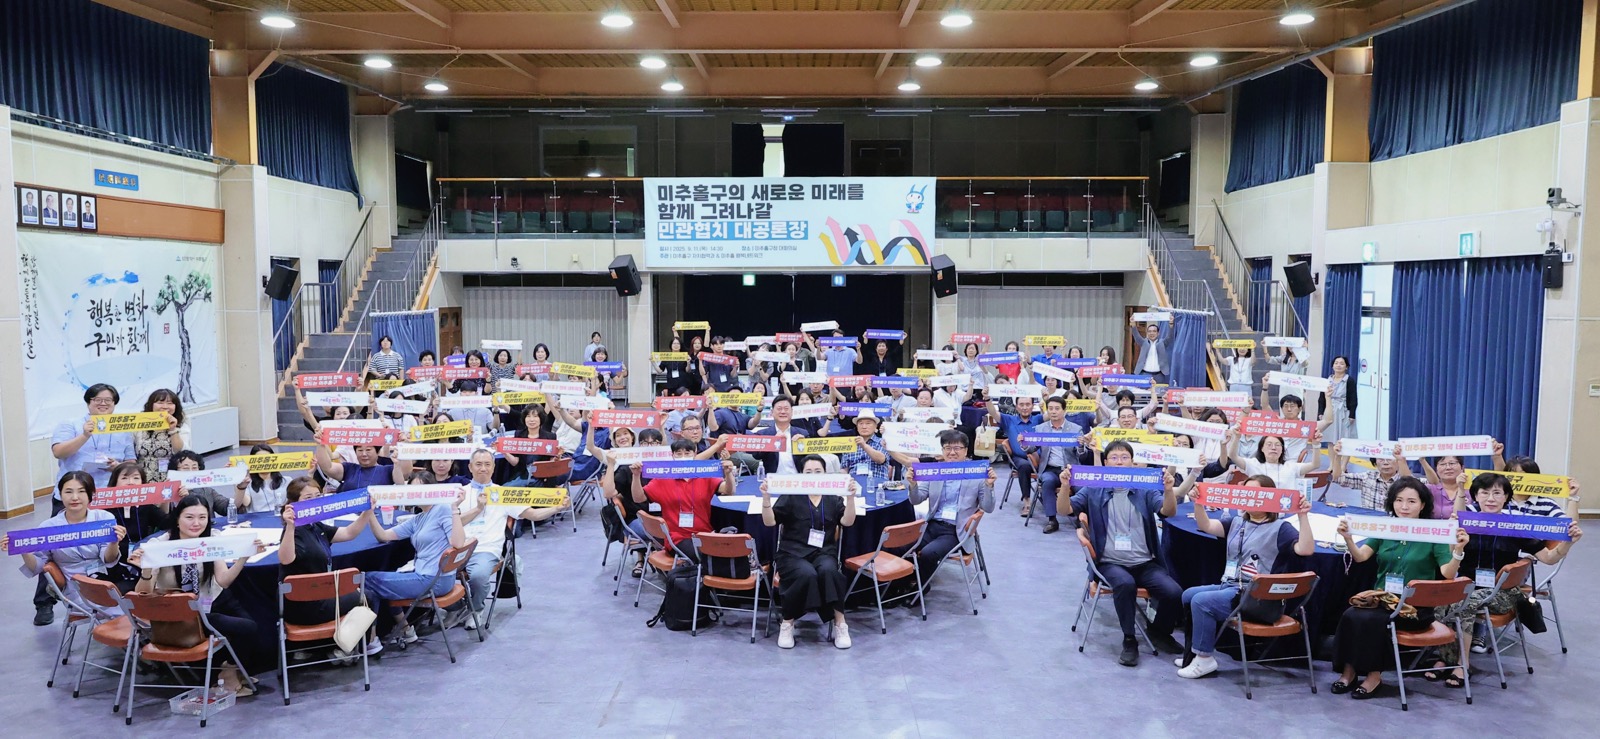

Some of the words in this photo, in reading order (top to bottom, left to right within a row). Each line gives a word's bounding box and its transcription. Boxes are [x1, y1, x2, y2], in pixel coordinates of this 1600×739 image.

[658, 184, 744, 202] 미추홀구의
[752, 184, 804, 201] 새로운
[811, 184, 864, 201] 미래를
[658, 202, 694, 220] 함께
[700, 202, 773, 220] 그려나갈
[658, 221, 728, 239] 민관협치
[734, 221, 807, 239] 대공론장
[87, 299, 122, 328] 행복한
[124, 287, 148, 328] 변화
[85, 328, 124, 356] 구민과
[127, 322, 150, 355] 함께
[1456, 442, 1488, 450] 네트워크
[1074, 472, 1101, 480] 미추홀구
[1104, 474, 1131, 482] 민관협치
[374, 492, 405, 500] 미추홀구
[425, 491, 454, 499] 네트워크
[1207, 487, 1230, 495] 주민과
[1232, 488, 1256, 498] 행정이
[1258, 490, 1274, 498] 함께
[1206, 495, 1229, 504] 만드는
[1231, 497, 1264, 507] 미추홀구
[1351, 522, 1387, 532] 미추홀구
[1390, 525, 1408, 534] 행복
[1411, 526, 1450, 537] 네트워크
[1462, 520, 1496, 528] 미추홀구
[1498, 522, 1532, 531] 민관협치
[14, 536, 45, 547] 미추홀구
[48, 533, 80, 543] 민관협치
[168, 549, 188, 560] 새로운
[189, 549, 205, 558] 변화
